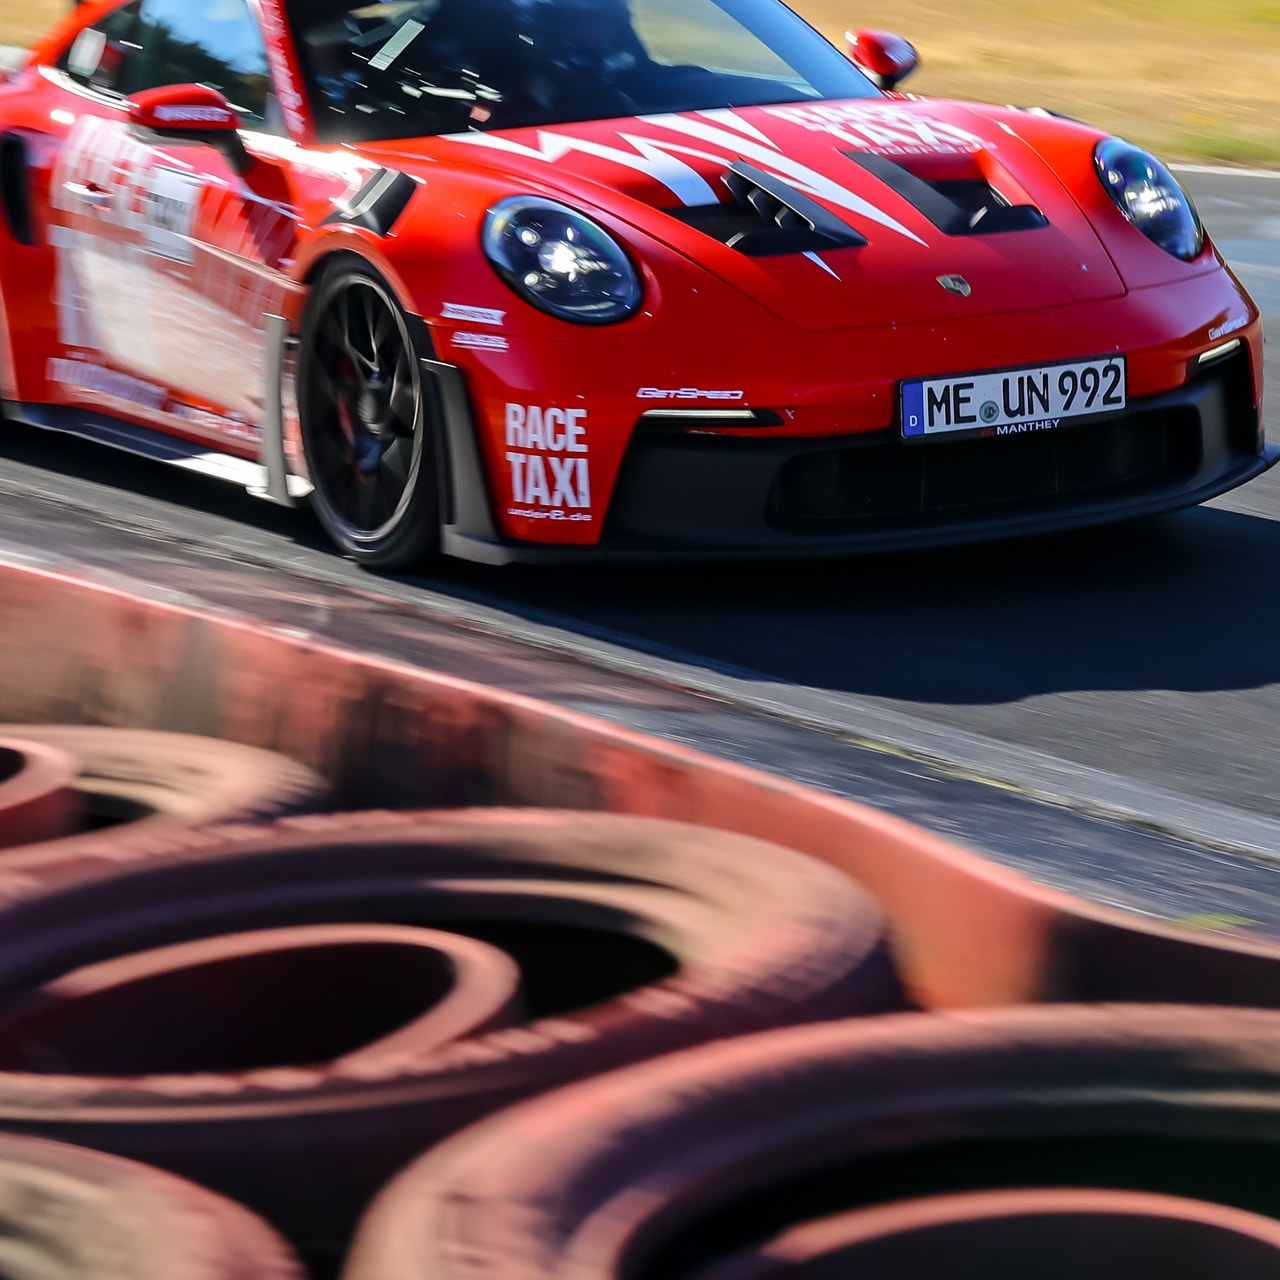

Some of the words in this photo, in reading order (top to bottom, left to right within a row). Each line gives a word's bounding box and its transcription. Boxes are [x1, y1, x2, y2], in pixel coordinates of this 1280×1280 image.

[909, 415, 918, 427] D
[927, 382, 977, 427] ME
[1002, 373, 1050, 418] UN
[1058, 364, 1122, 411] 992
[505, 402, 589, 453] RACE
[996, 418, 1061, 436] MANTHEY
[505, 451, 591, 508] TAXI
